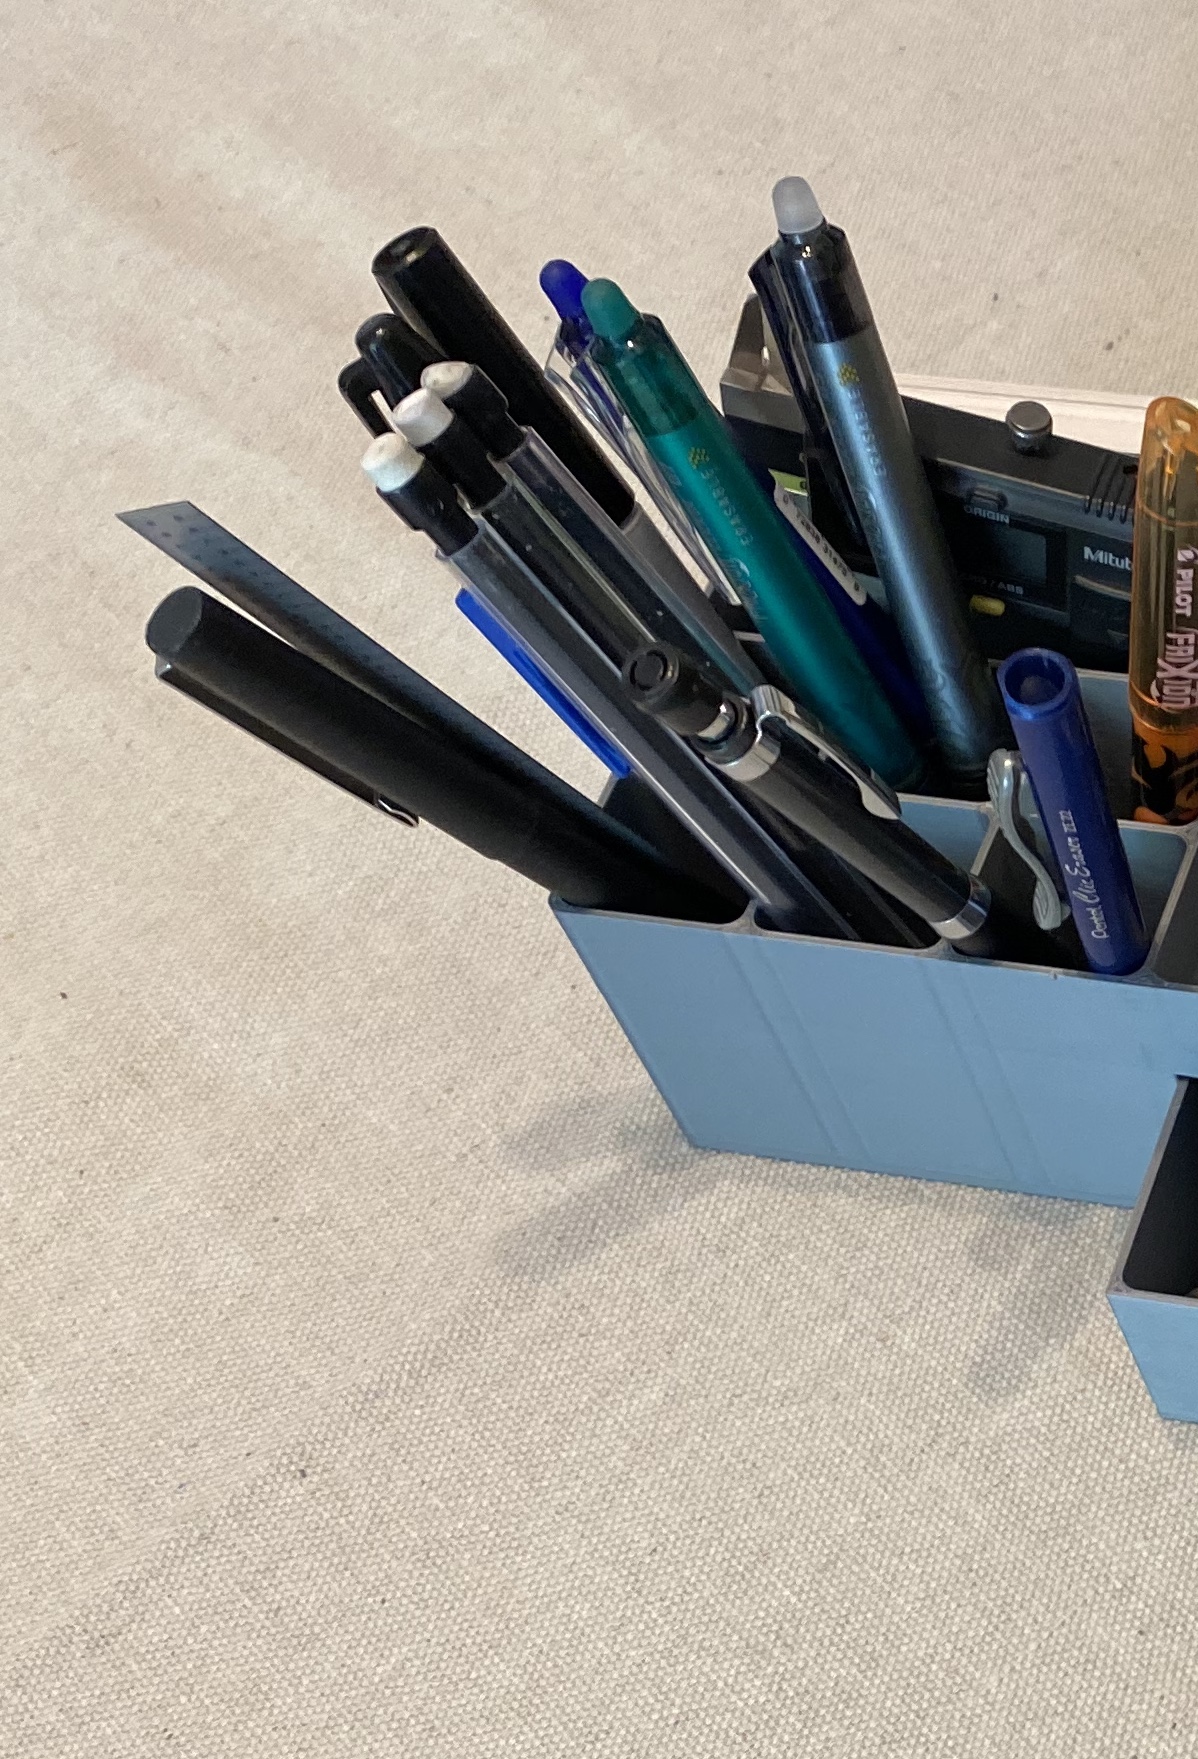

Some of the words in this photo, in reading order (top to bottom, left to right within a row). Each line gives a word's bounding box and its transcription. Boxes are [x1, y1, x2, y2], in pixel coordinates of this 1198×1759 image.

[701, 467, 754, 546] ERASABLE
[964, 506, 1010, 525] ORIGIN
[1083, 545, 1133, 571] Mitut
[1174, 568, 1195, 618] PILOT
[1072, 877, 1100, 904] Clic
